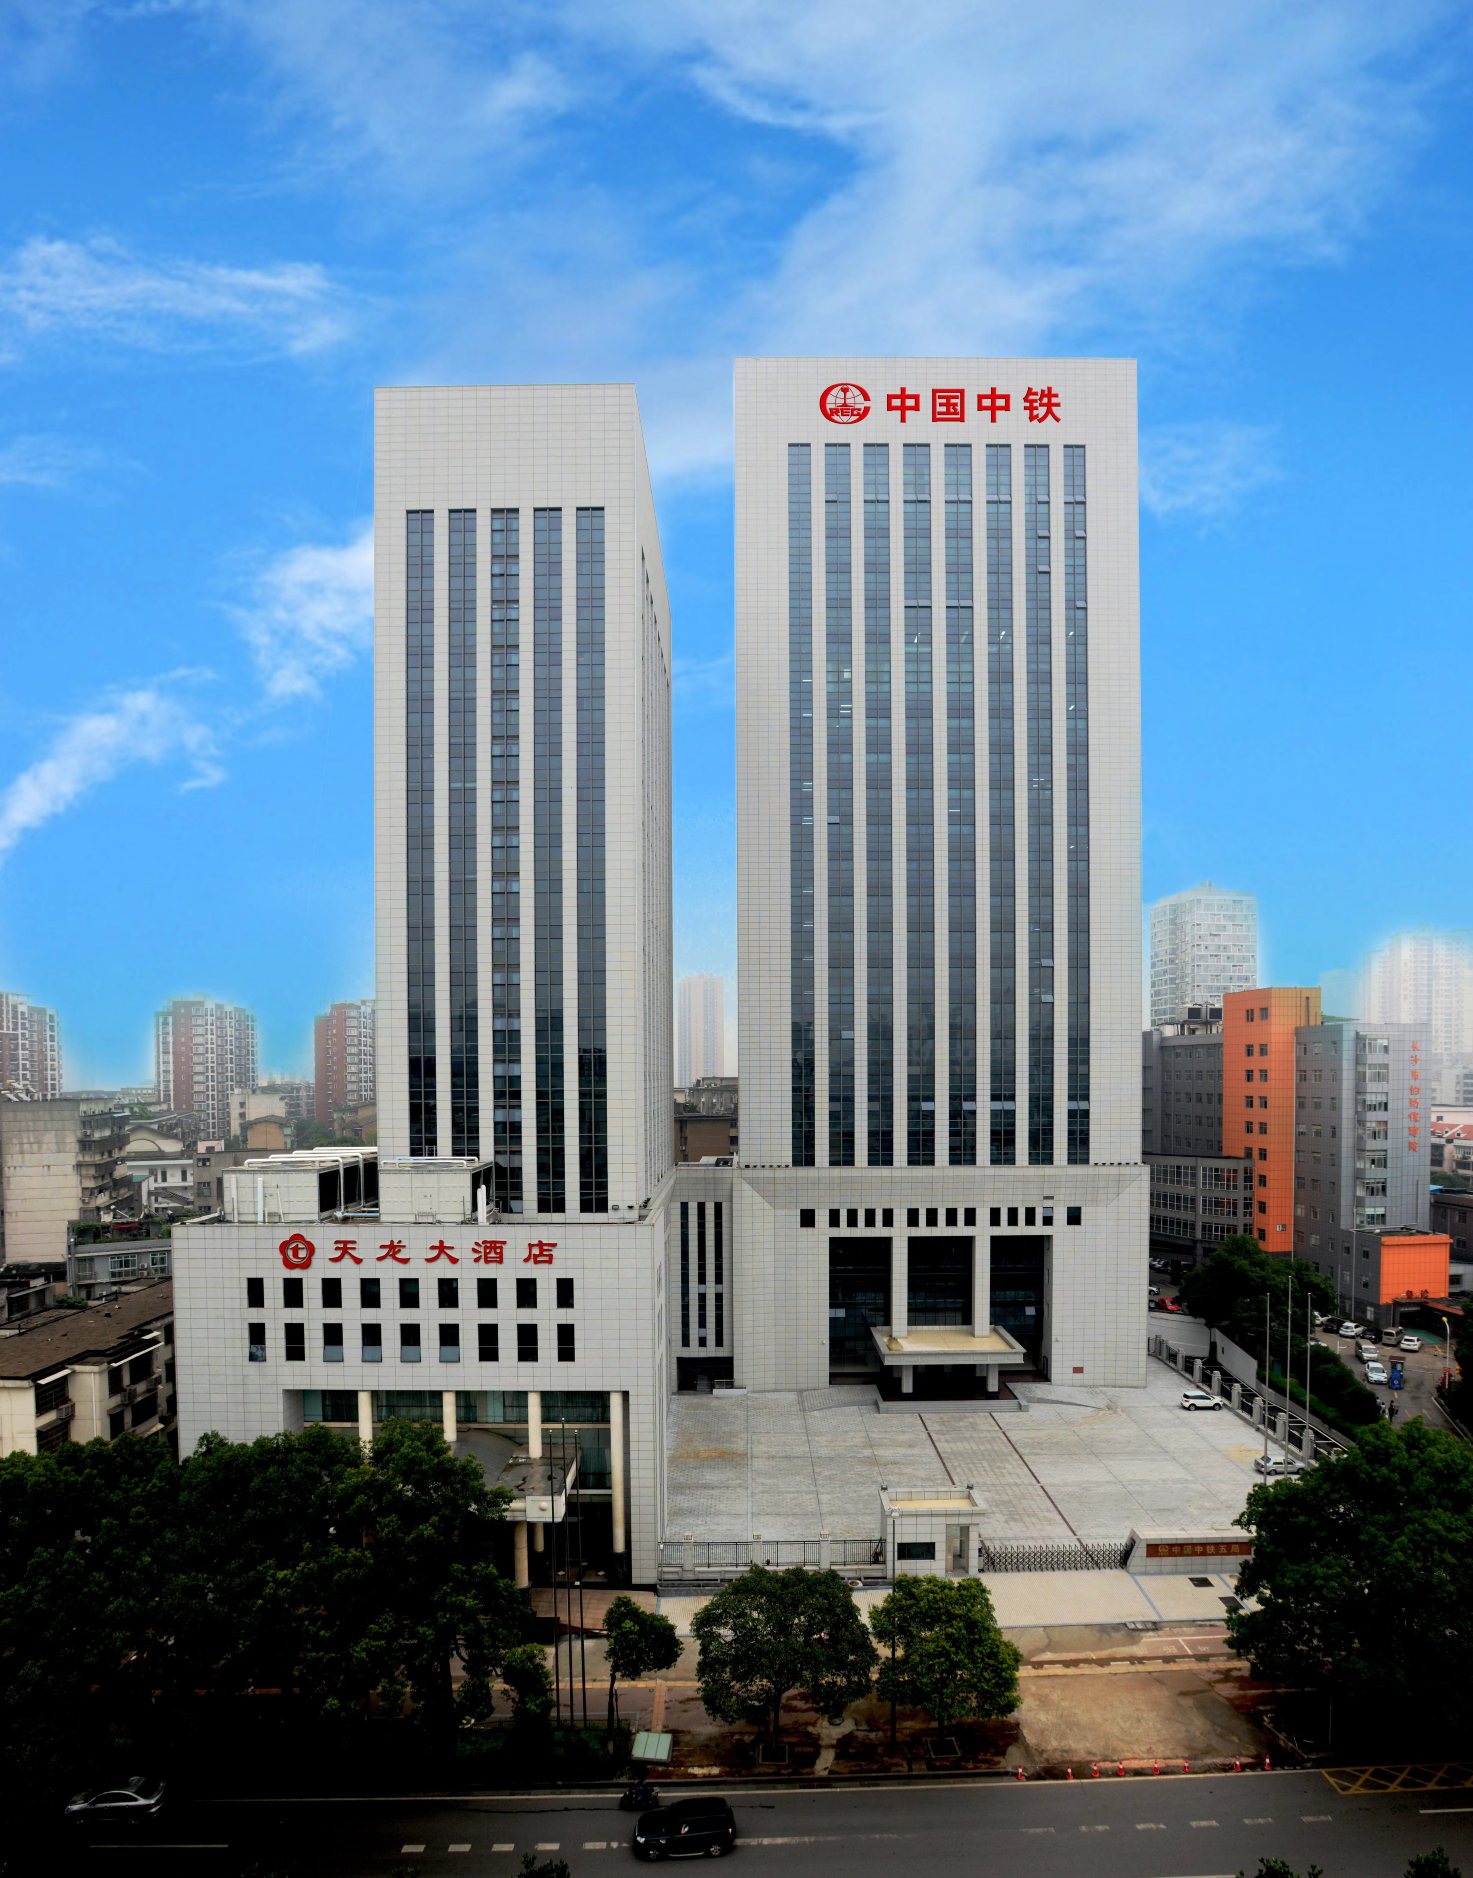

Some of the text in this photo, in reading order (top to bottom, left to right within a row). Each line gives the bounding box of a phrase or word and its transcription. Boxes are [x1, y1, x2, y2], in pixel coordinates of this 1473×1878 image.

[887, 386, 1061, 423] 中国中铁
[329, 1239, 558, 1265] 天龙大酒店
[1172, 1544, 1240, 1555] 中国中铁五局
